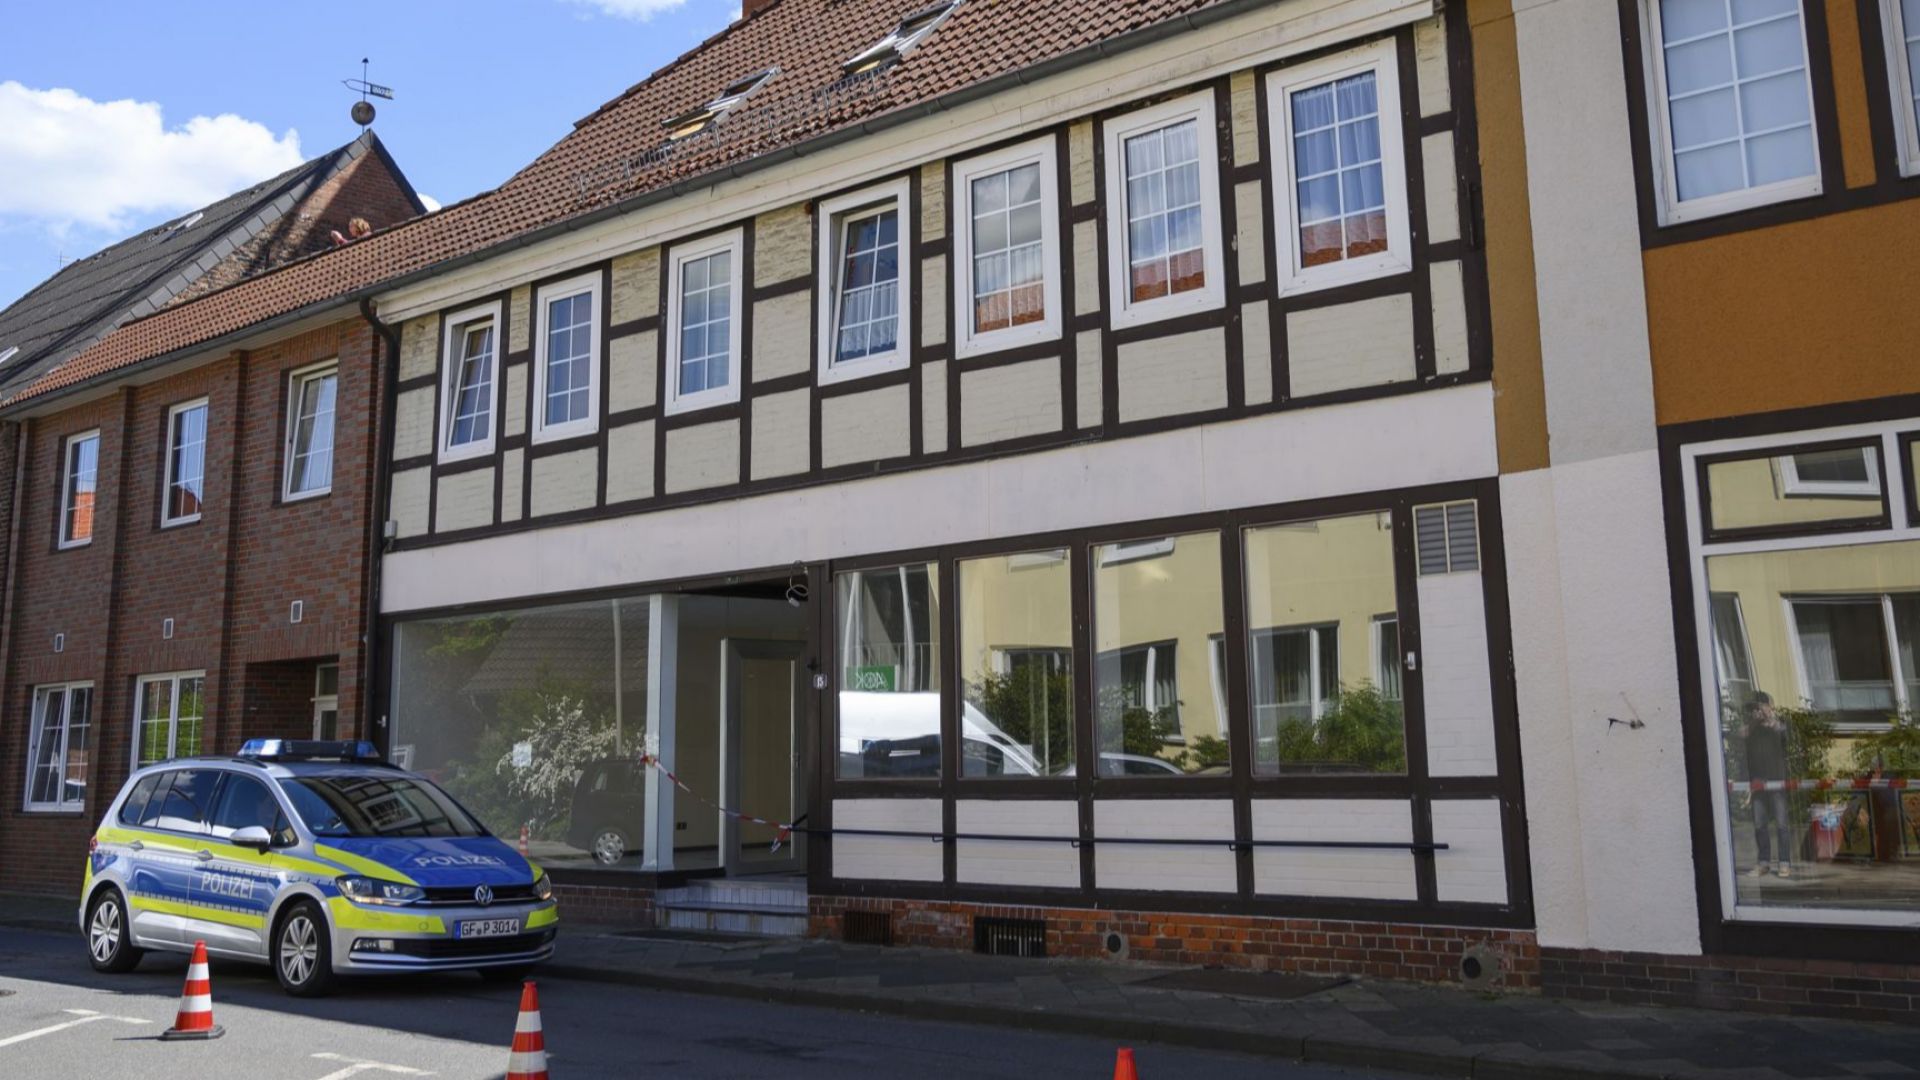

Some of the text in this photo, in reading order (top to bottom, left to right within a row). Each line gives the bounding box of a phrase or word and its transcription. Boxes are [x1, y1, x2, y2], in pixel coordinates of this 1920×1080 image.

[413, 856, 507, 867] POLIZEI
[200, 871, 255, 900] POLIZEI
[461, 920, 518, 936] GF P 3014
